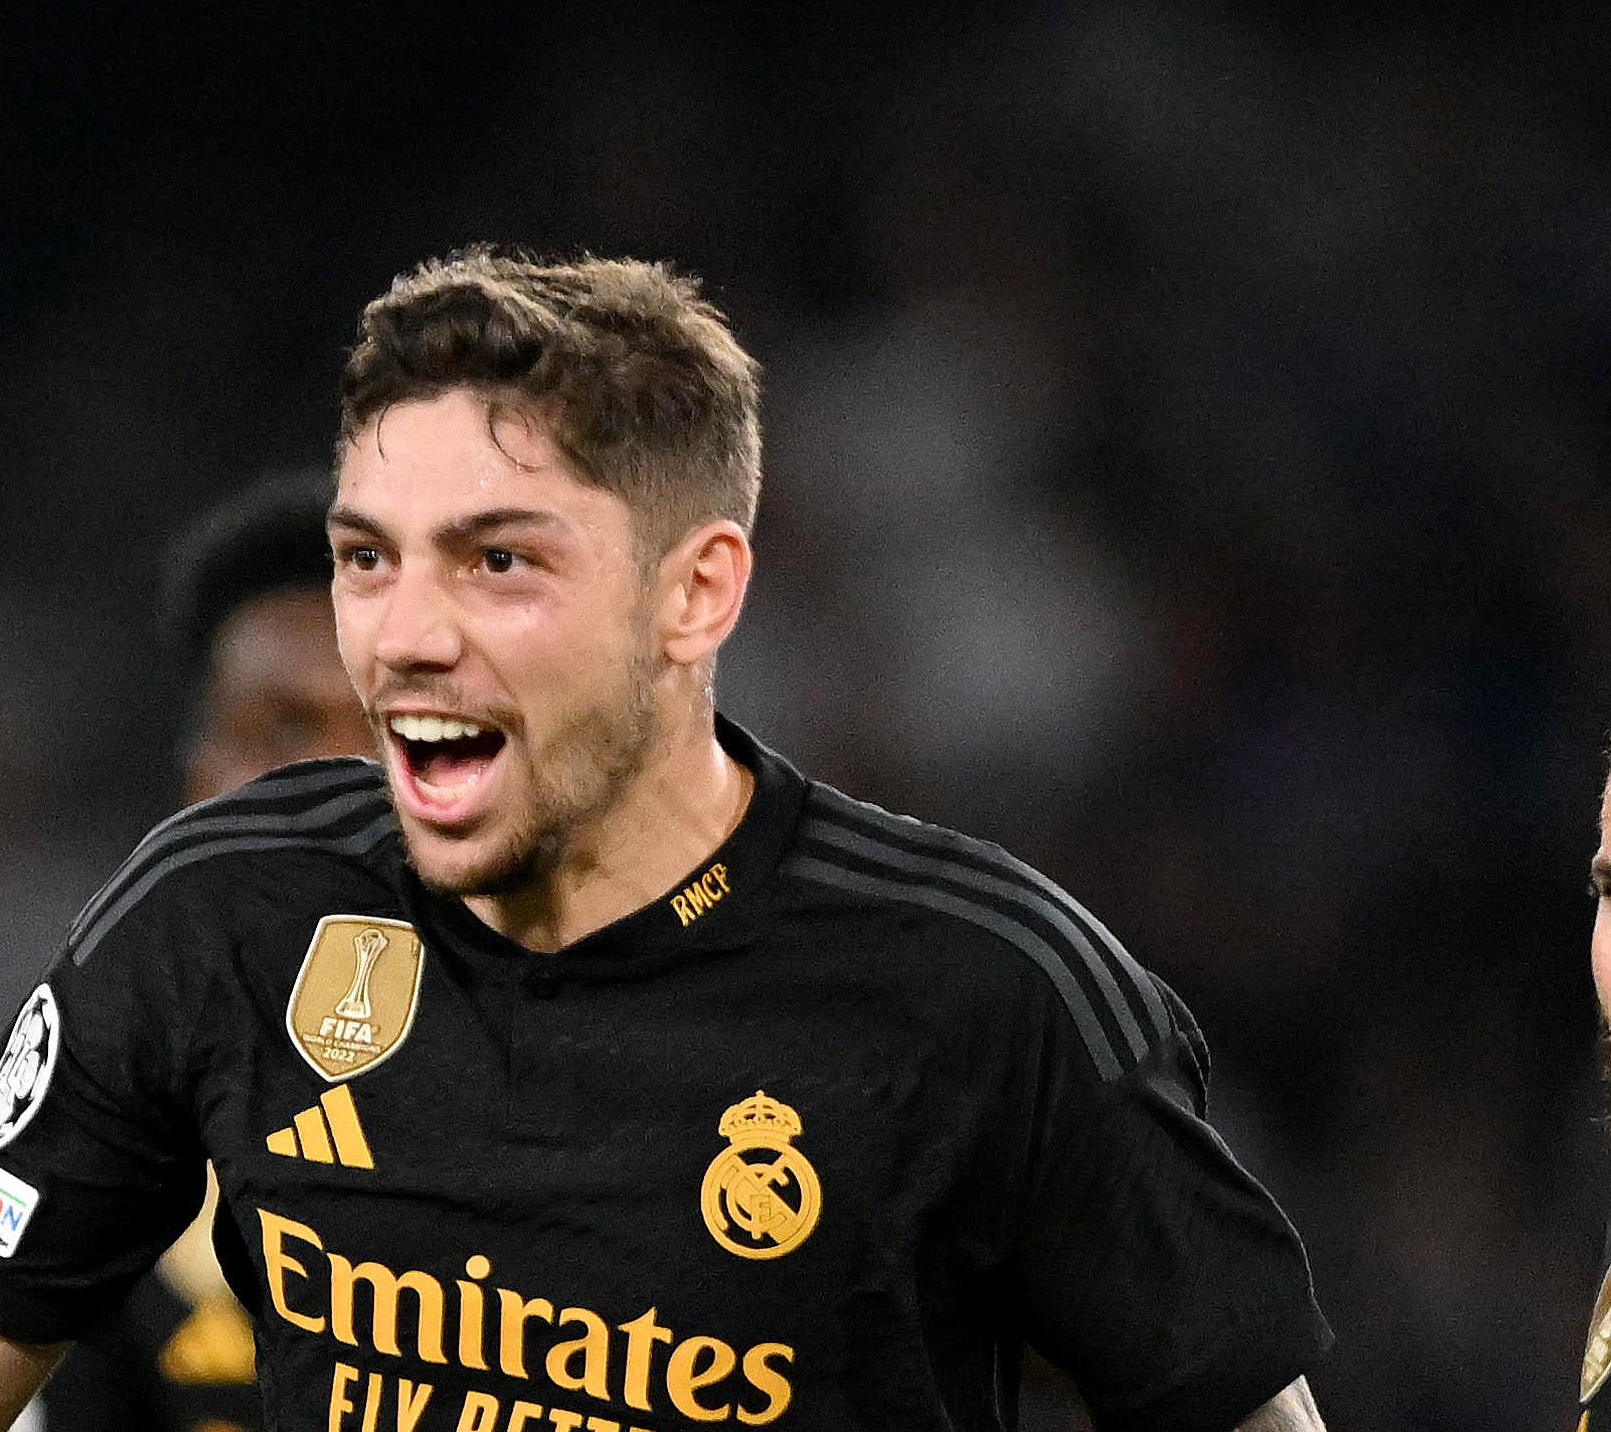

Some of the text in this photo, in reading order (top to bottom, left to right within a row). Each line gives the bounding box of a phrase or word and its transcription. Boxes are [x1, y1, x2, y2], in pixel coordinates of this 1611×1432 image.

[319, 1017, 373, 1044] FIFA
[322, 1046, 357, 1063] 2022
[256, 1207, 796, 1426] Emirates
